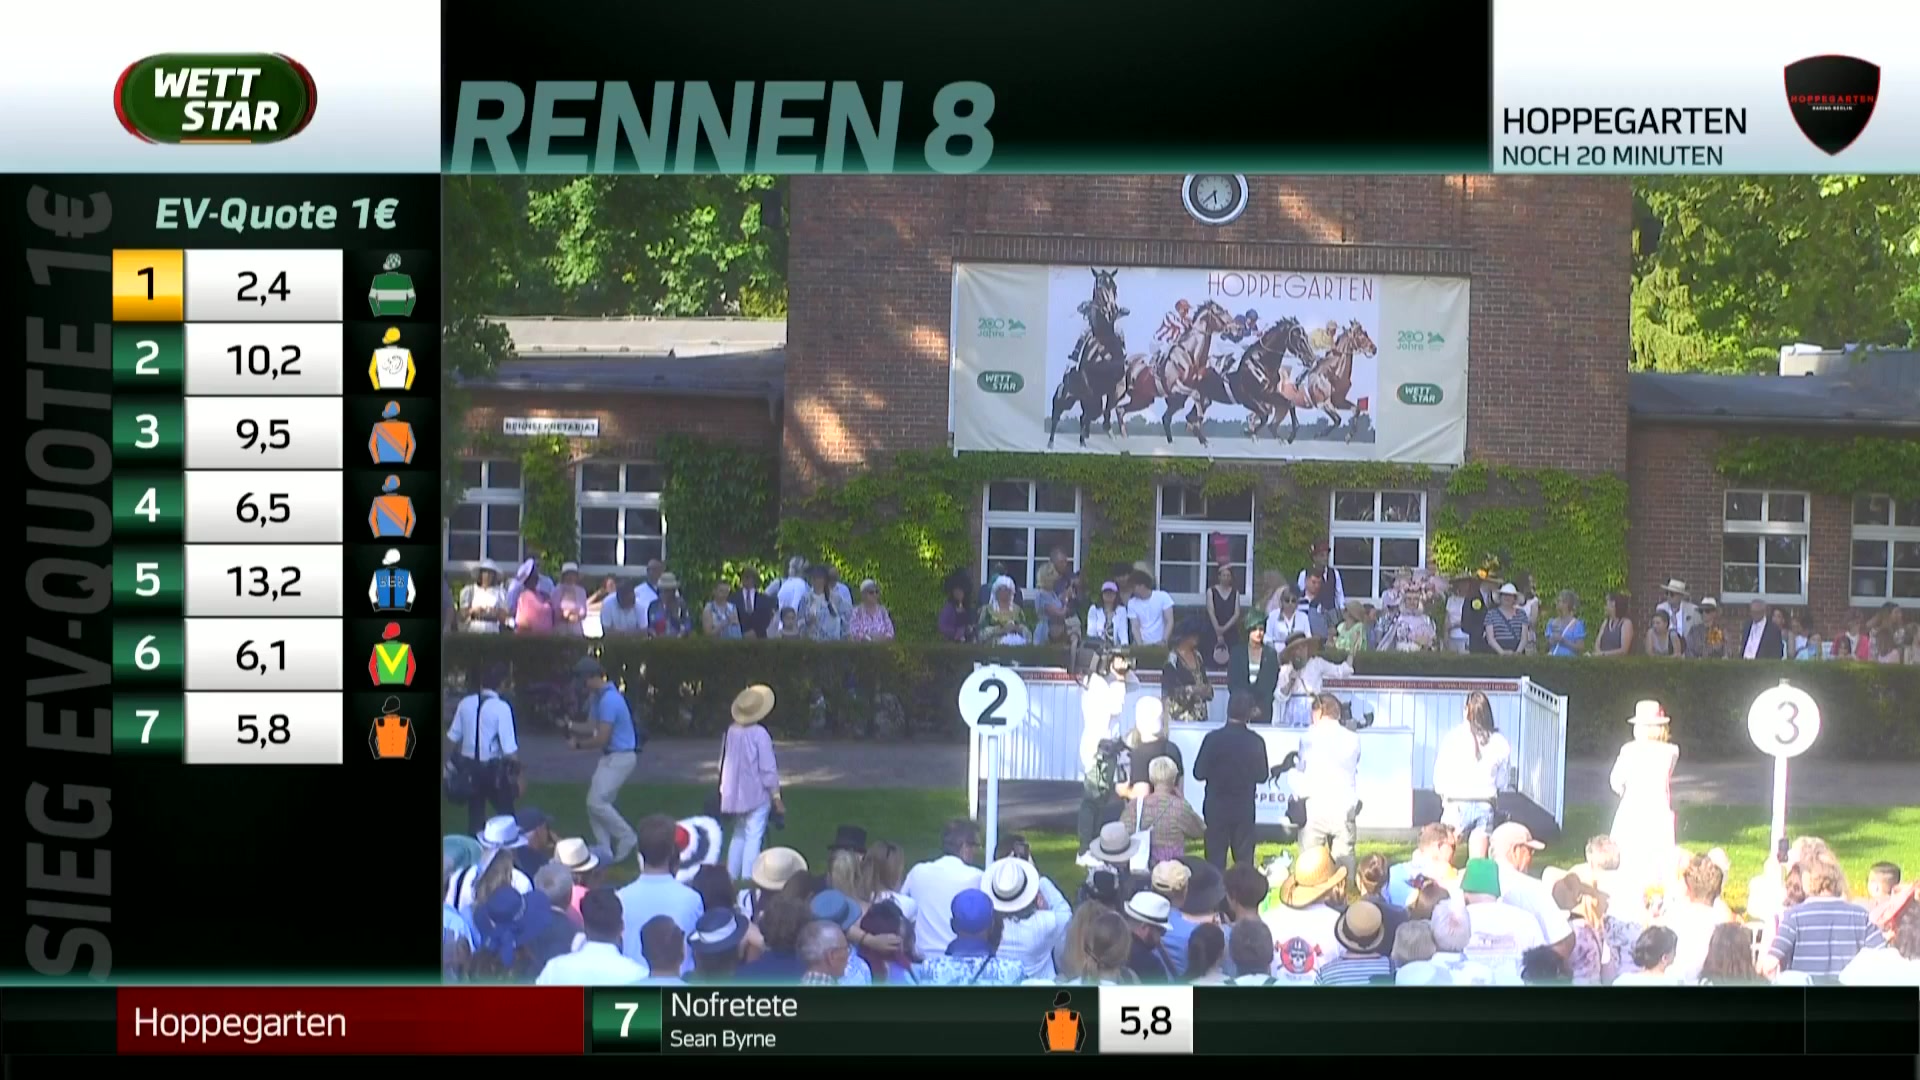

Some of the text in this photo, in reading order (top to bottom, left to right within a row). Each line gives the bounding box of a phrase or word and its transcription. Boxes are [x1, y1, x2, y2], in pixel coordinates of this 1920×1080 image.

[1208, 272, 1373, 301] HOPPEGARTEN
[985, 373, 1012, 383] WETT
[992, 382, 1017, 392] STAR
[1405, 385, 1432, 395] WETT
[1412, 394, 1436, 404] STAR
[976, 678, 1008, 726] 2
[1775, 701, 1800, 745] 3
